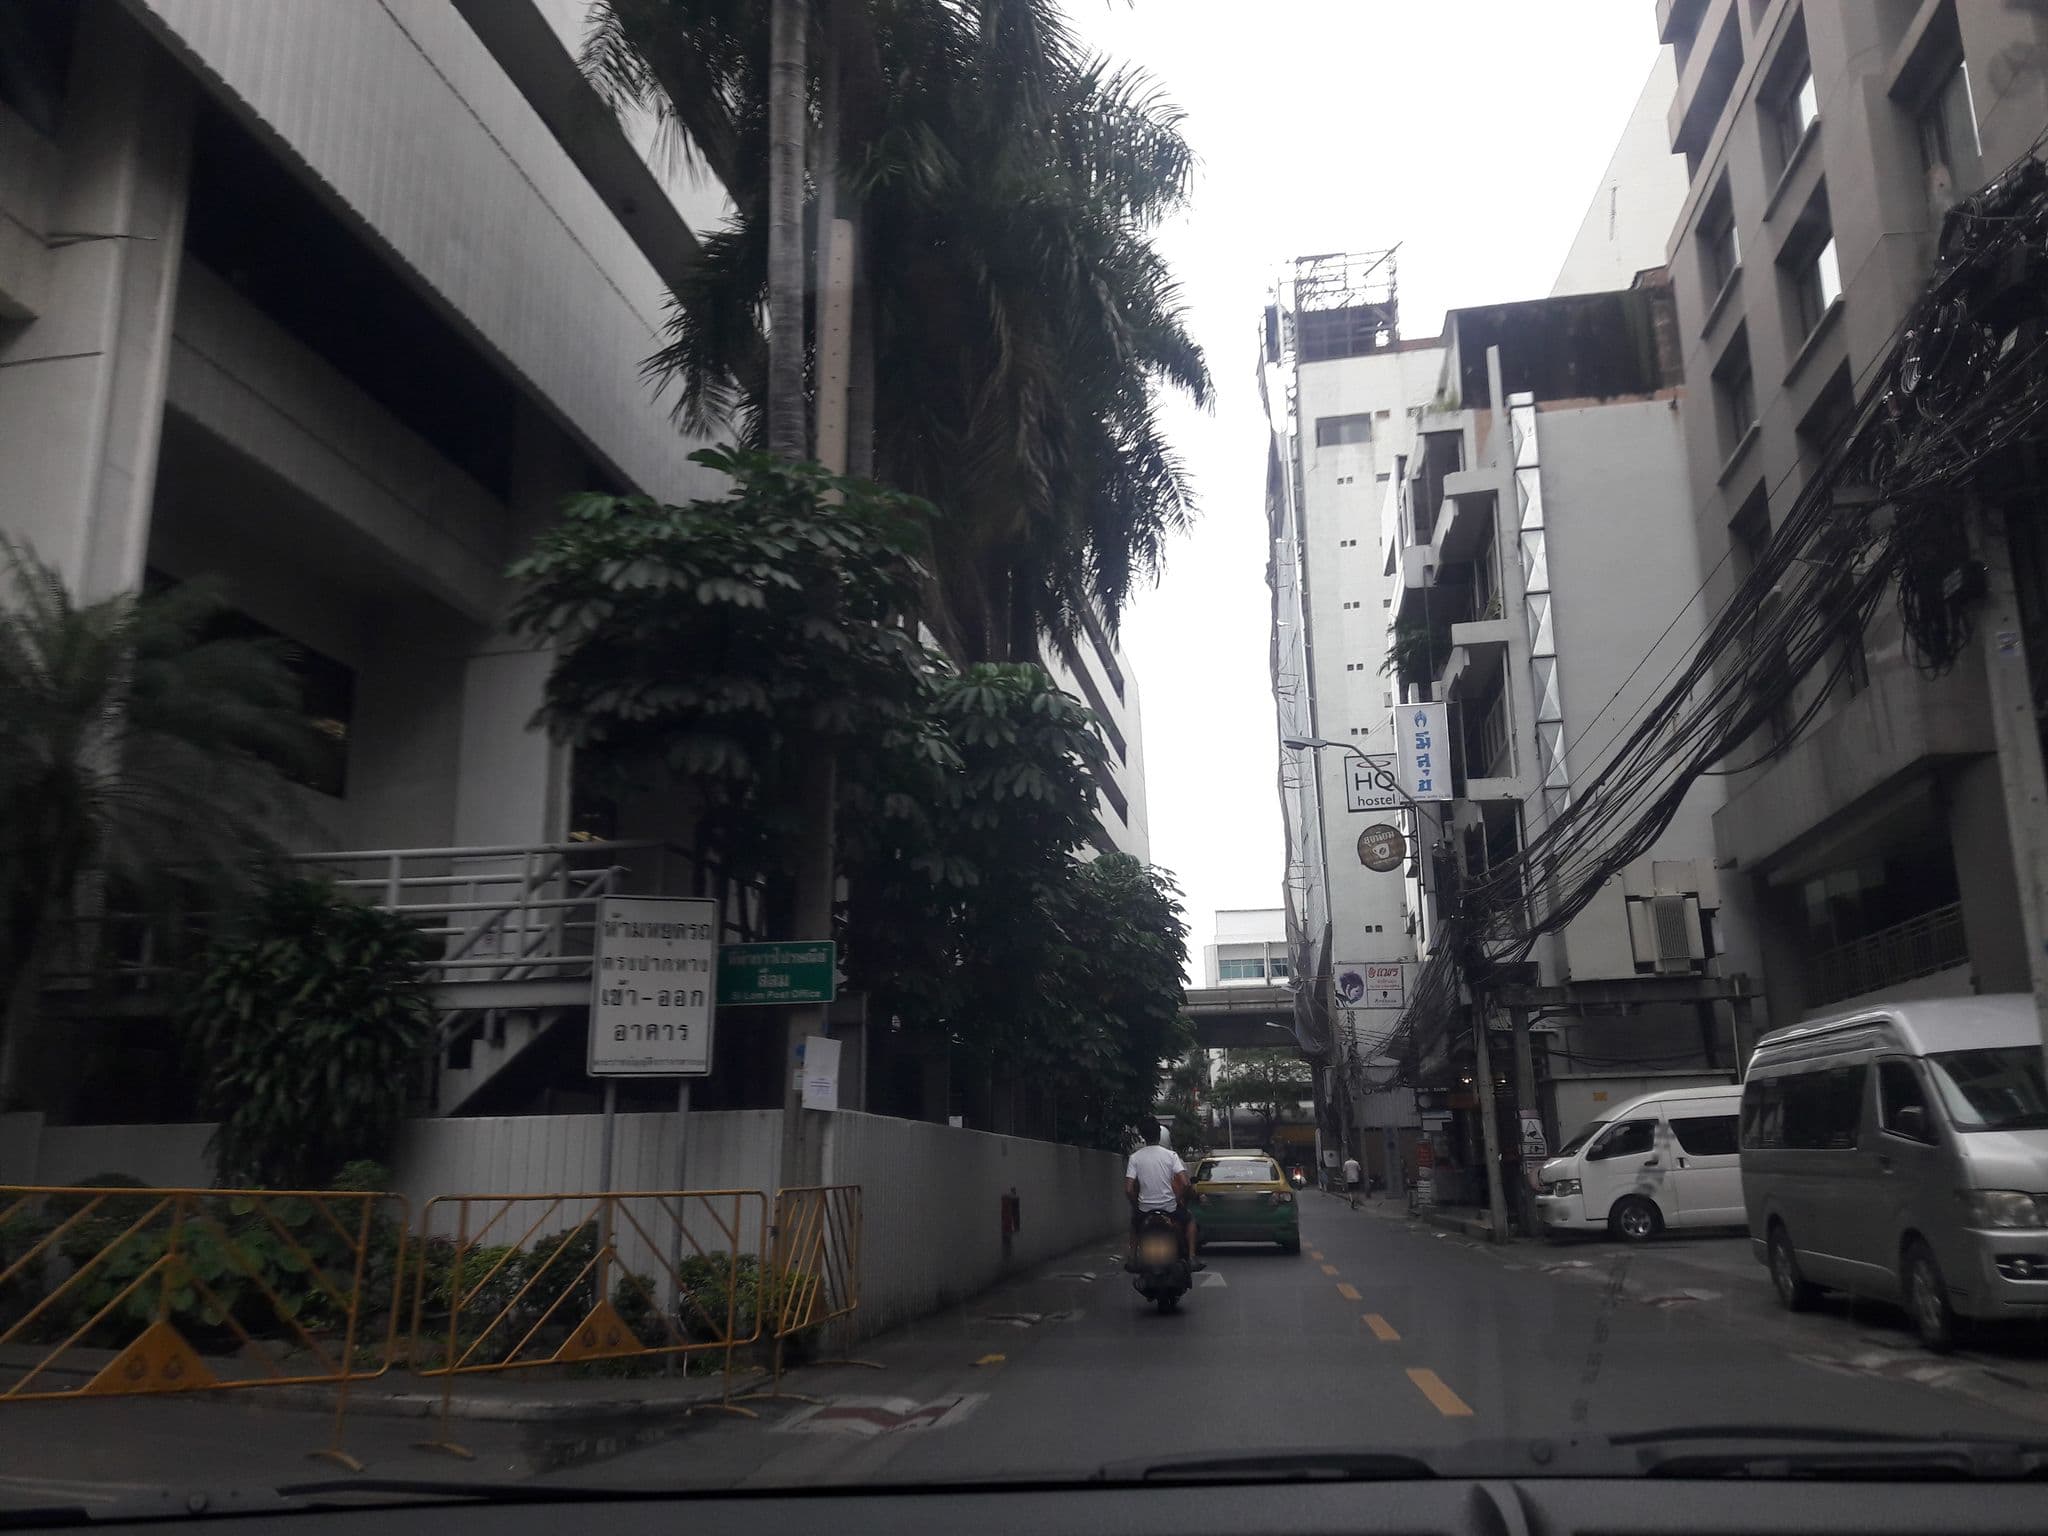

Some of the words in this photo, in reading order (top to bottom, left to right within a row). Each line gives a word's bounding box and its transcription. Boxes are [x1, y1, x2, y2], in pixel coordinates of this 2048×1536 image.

[1354, 770, 1396, 792] HQ
[1357, 794, 1396, 807] hostel
[766, 990, 788, 998] Post
[791, 989, 821, 998] Office
[613, 1023, 690, 1042] อาคาร
